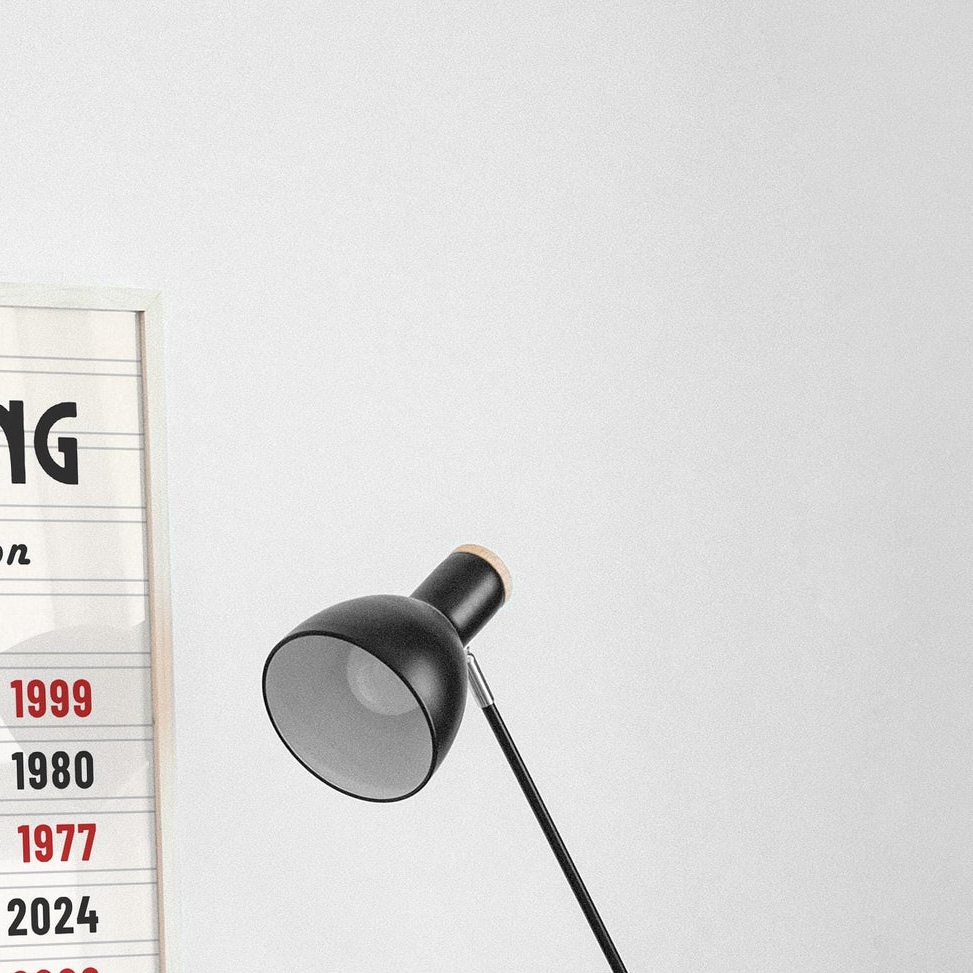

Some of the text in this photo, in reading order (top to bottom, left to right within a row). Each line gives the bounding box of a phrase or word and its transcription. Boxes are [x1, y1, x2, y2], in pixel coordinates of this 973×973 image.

[10, 678, 92, 719] 1999
[11, 750, 94, 790] 1980
[17, 823, 97, 863] 1977
[7, 895, 99, 937] 2024
